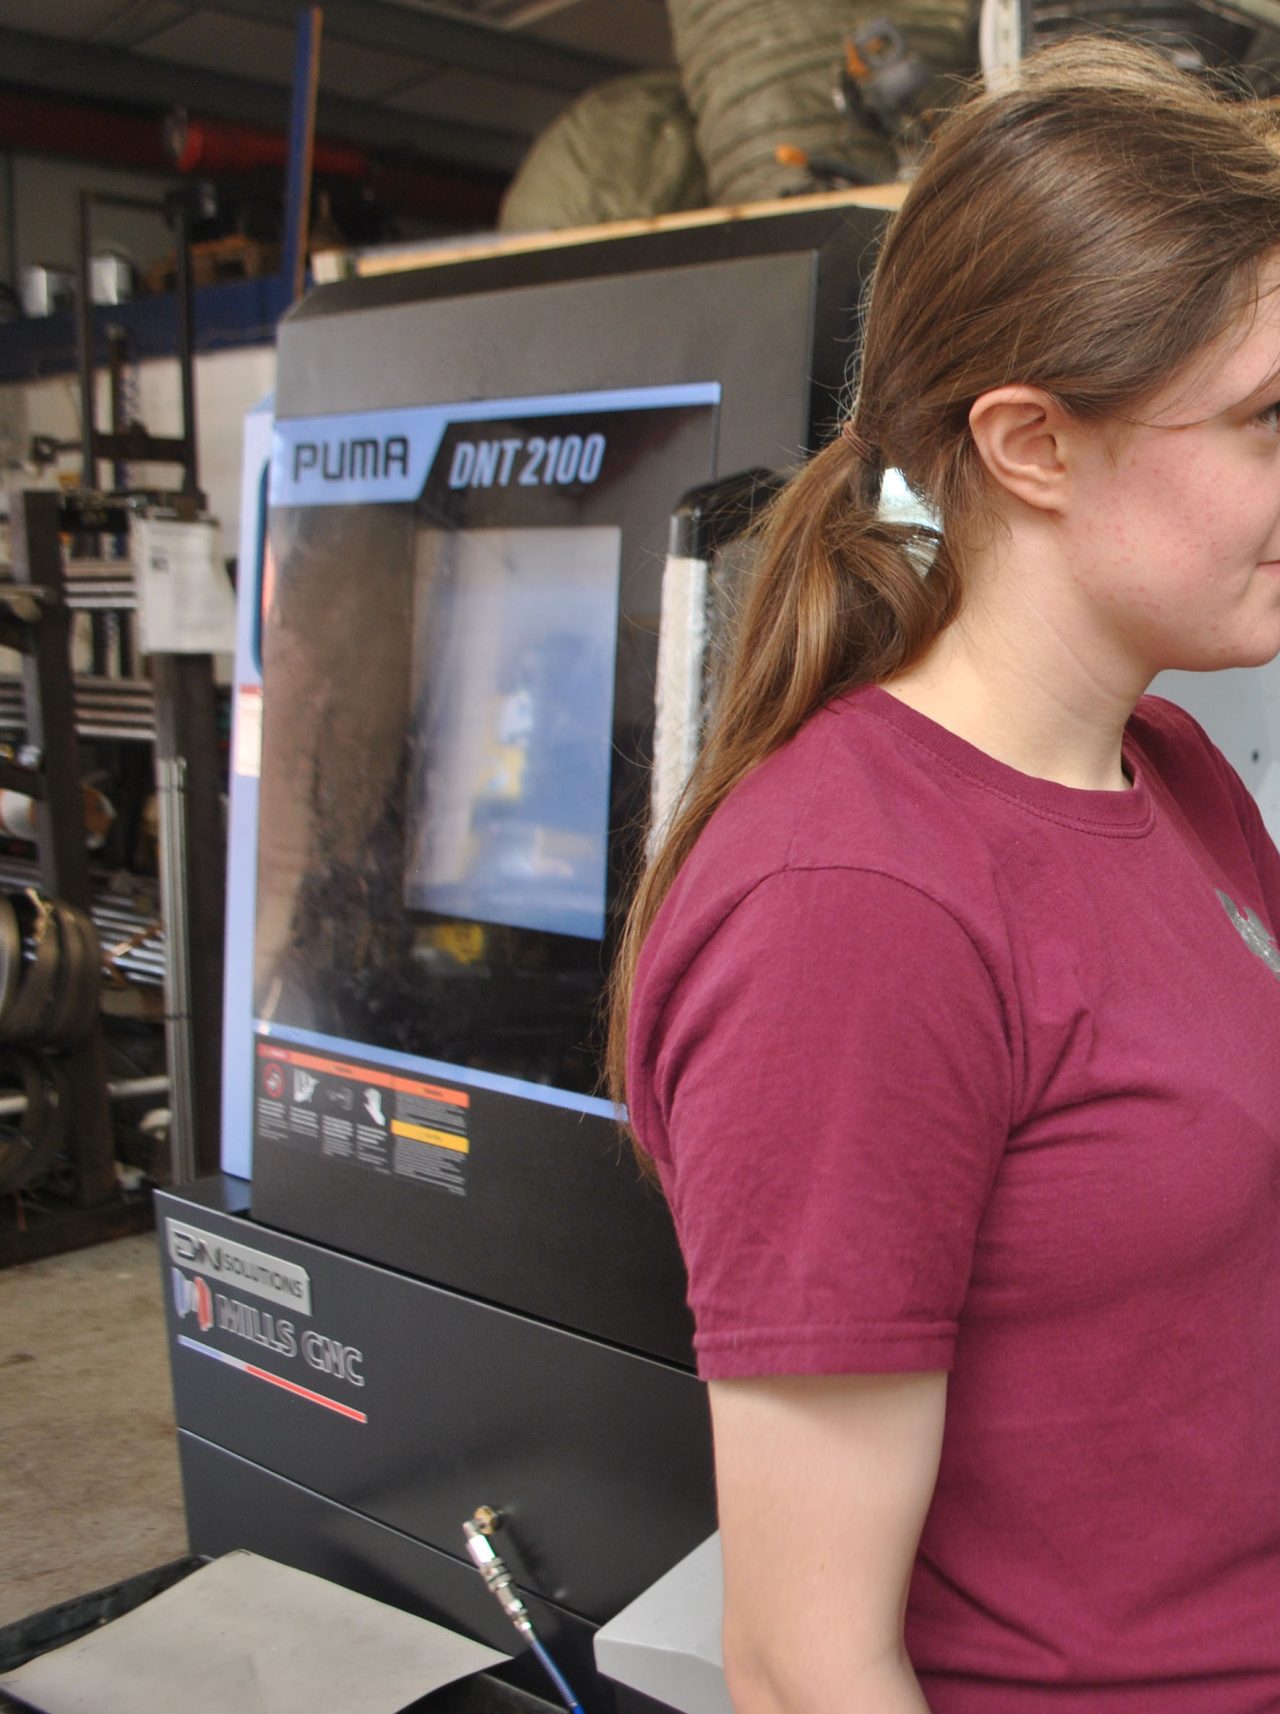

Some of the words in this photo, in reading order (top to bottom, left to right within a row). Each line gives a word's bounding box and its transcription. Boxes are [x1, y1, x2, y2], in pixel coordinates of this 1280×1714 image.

[293, 436, 408, 483] PUMA
[449, 438, 524, 489] DNT
[521, 433, 606, 486] 2100
[221, 1253, 303, 1299] SOLUTIONS
[217, 1295, 298, 1358] MILLS
[301, 1330, 366, 1387] CNC
